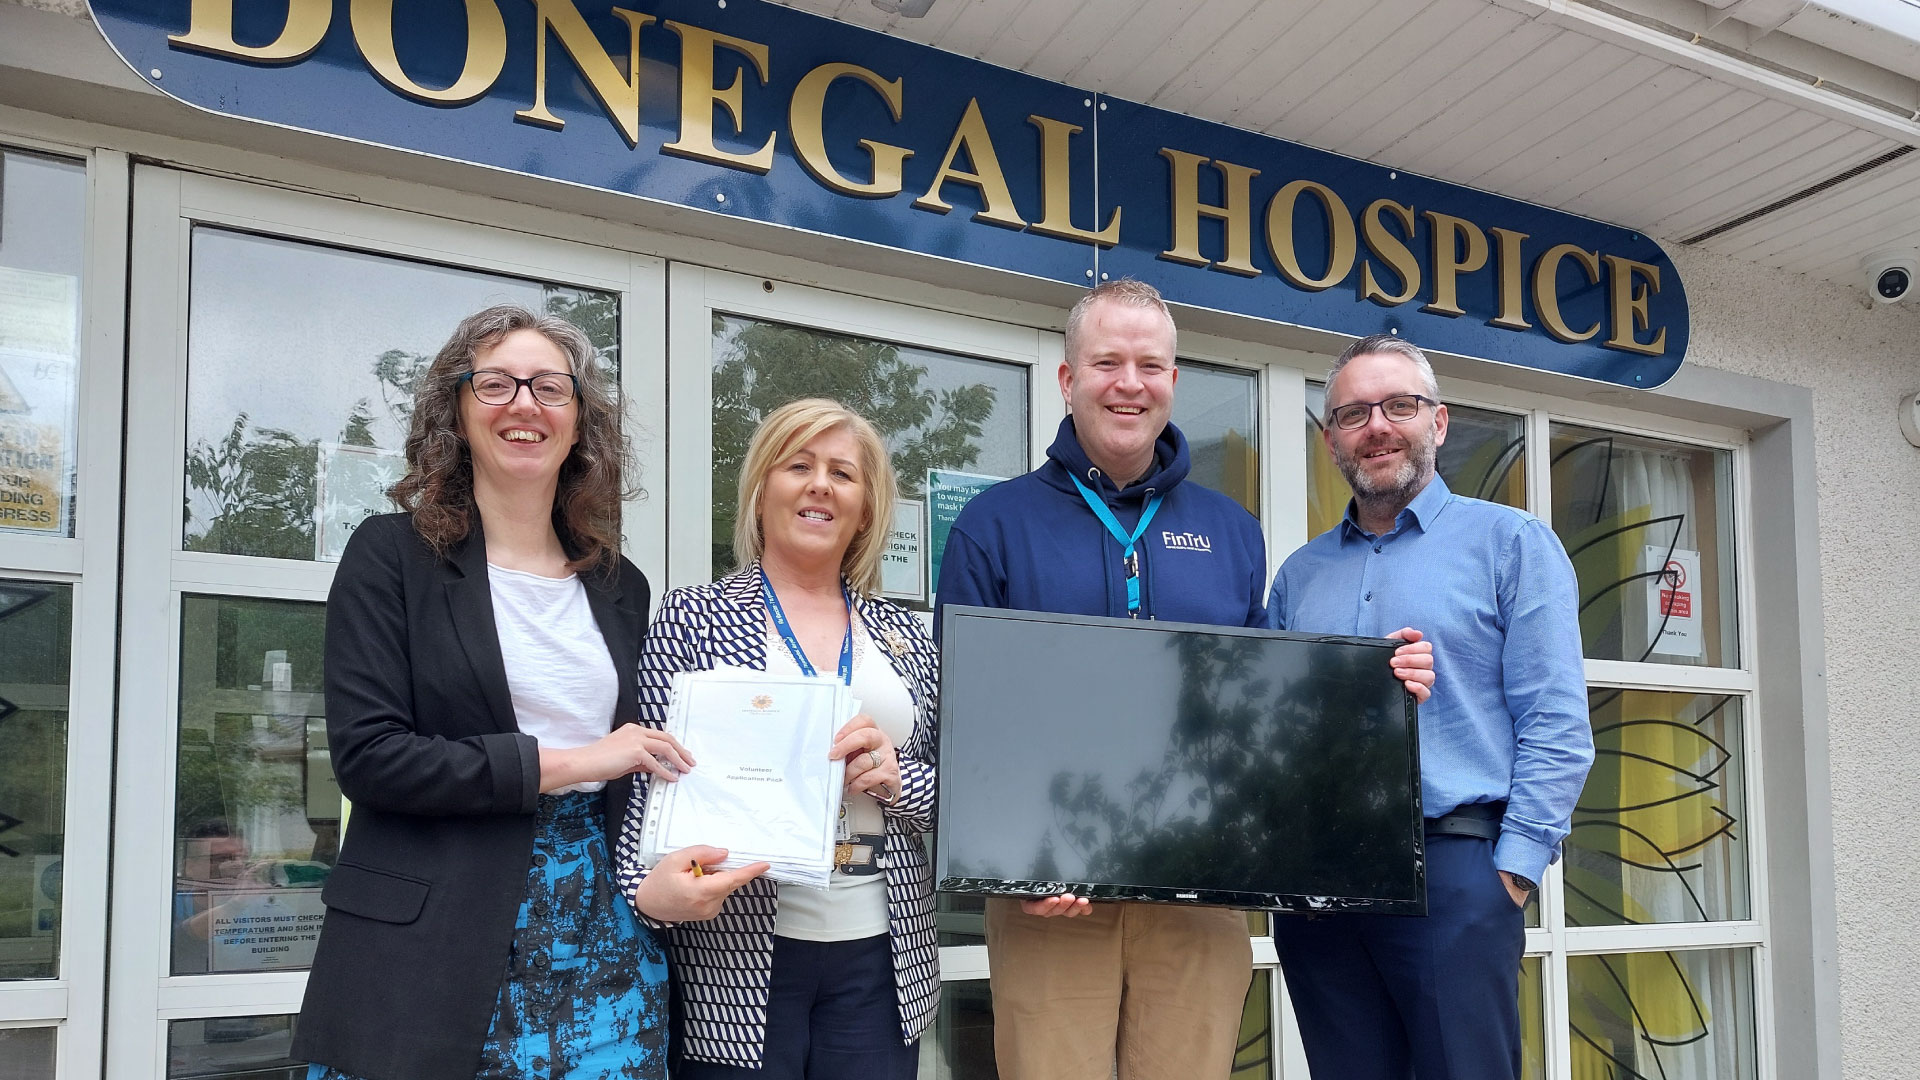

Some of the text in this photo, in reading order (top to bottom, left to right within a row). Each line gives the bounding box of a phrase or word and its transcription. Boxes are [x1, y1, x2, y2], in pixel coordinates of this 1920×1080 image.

[1157, 146, 1667, 356] HOSPICE
[937, 482, 951, 490] You
[953, 486, 970, 494] may
[937, 492, 946, 500] to
[937, 503, 958, 511] mask
[0, 507, 52, 522] RESS
[891, 555, 908, 563] THE
[726, 774, 765, 782] Application
[233, 916, 272, 924] VISITORS
[214, 926, 275, 935] TEMPERATURE
[223, 937, 256, 945] BEFORE
[258, 935, 299, 943] ENTERING
[251, 946, 290, 954] BUILDING
